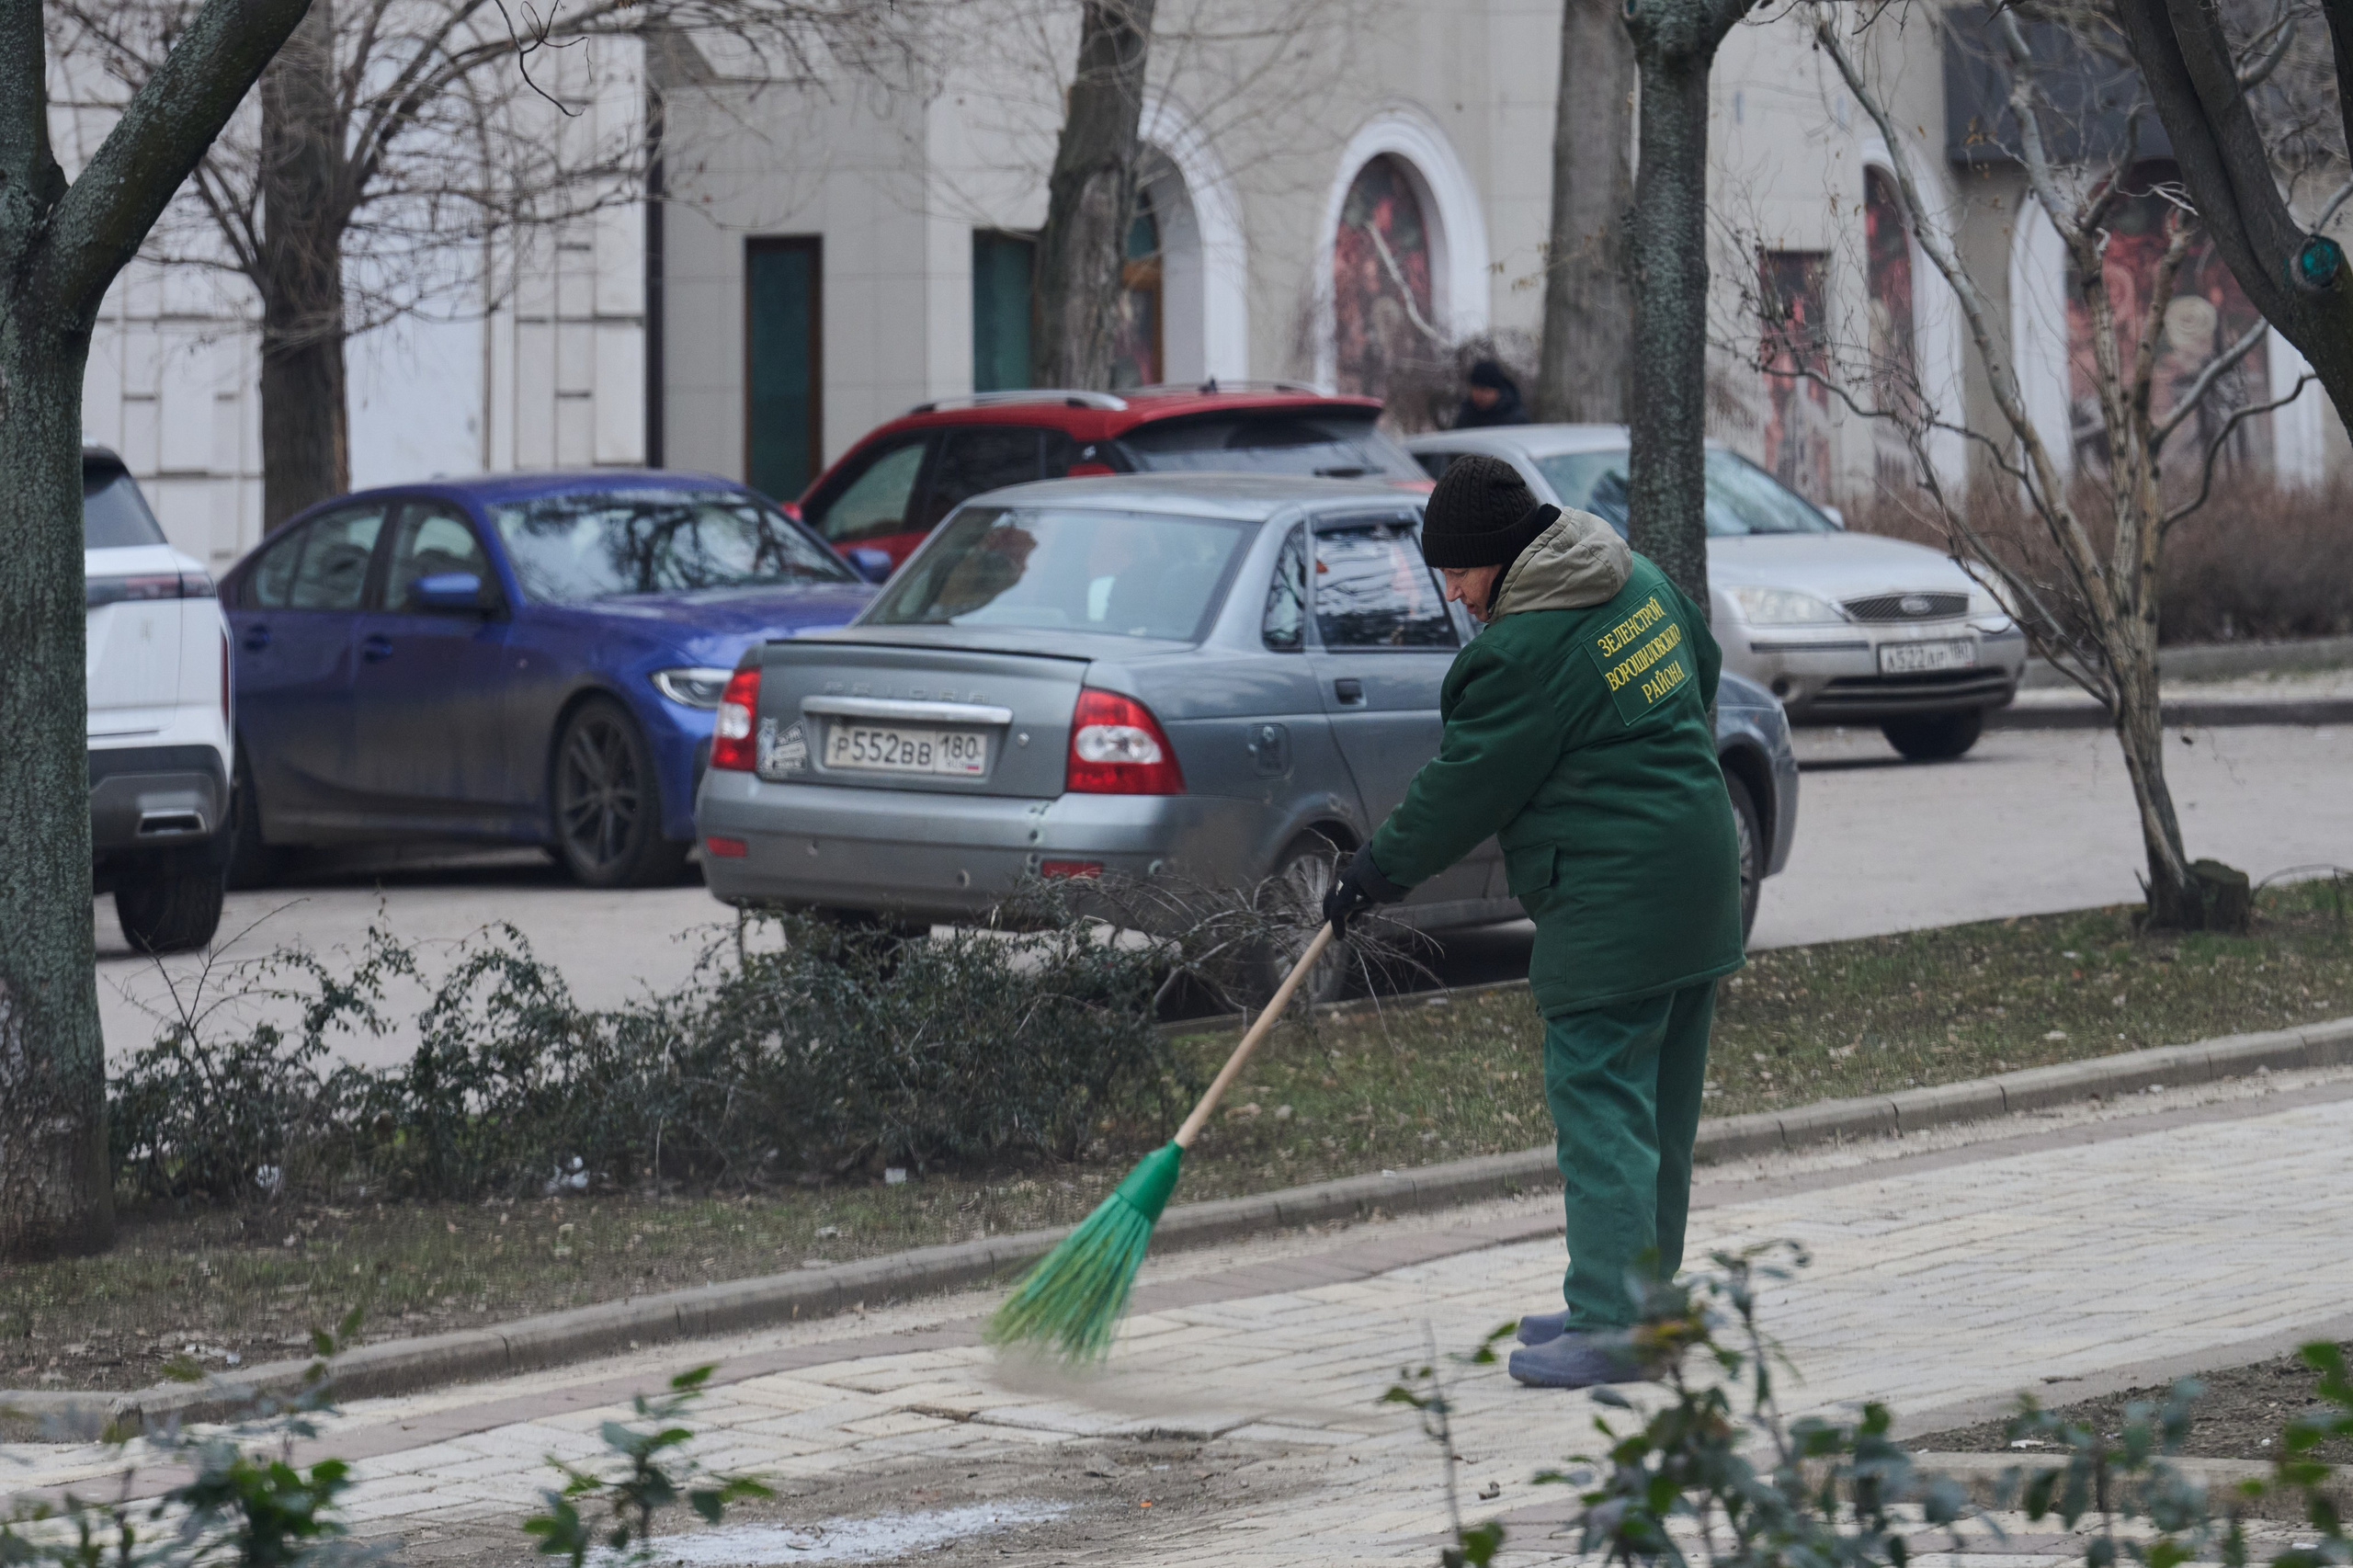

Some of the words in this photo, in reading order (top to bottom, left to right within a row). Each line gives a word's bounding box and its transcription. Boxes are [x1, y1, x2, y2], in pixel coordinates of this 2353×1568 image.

[1597, 597, 1666, 657] ЗЕЛЕНСТРОЙ
[1642, 660, 1685, 704] РАЙОНА
[938, 735, 977, 759] 180
